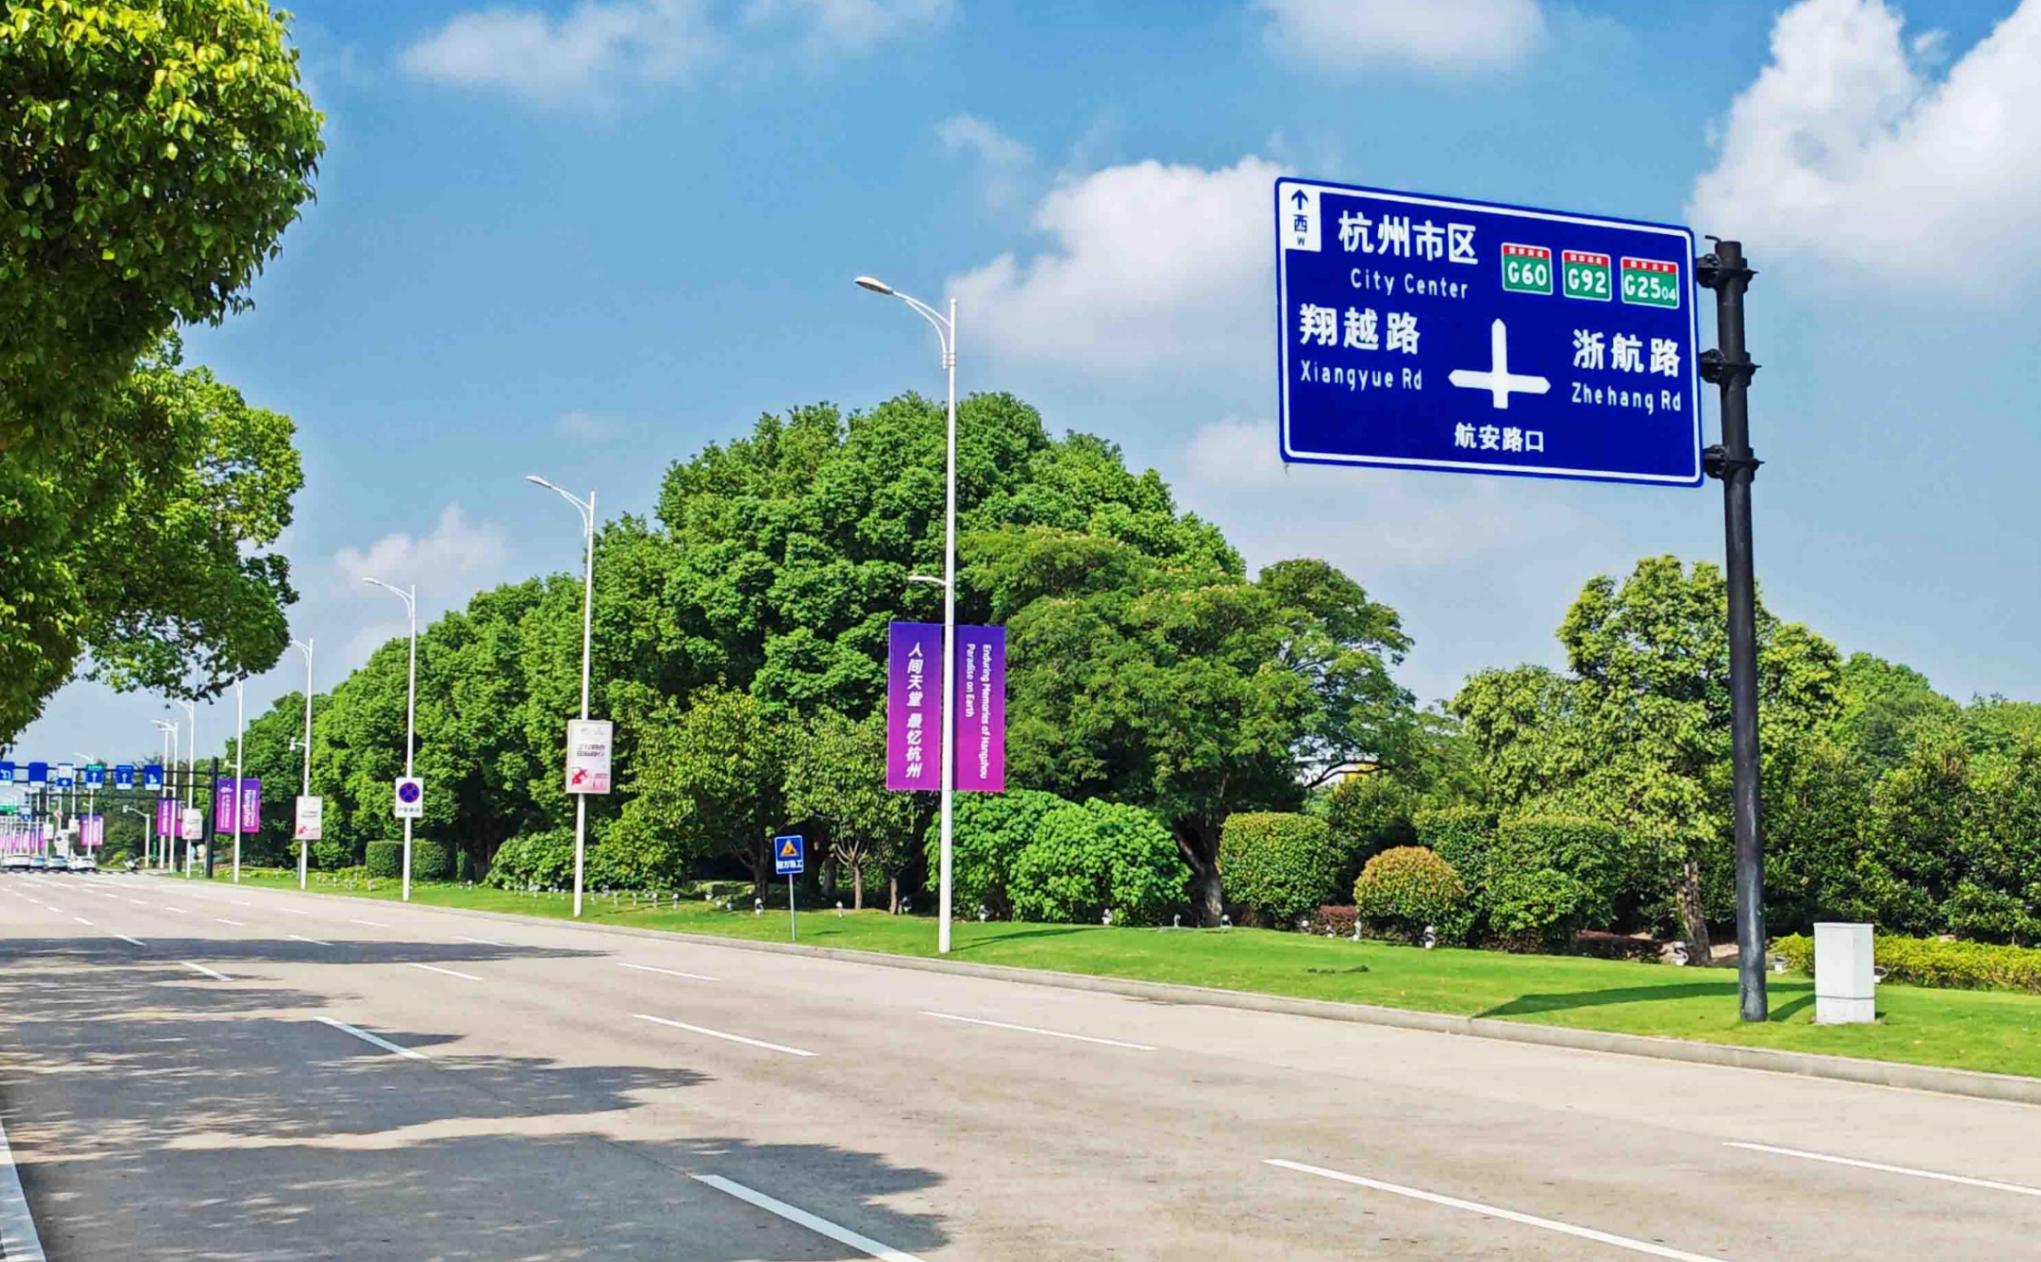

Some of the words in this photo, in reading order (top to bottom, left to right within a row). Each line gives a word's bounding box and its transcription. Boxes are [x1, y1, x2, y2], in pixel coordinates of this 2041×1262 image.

[1293, 214, 1308, 233] 西
[1338, 210, 1478, 264] 杭州市区
[1297, 236, 1304, 246] W
[1351, 268, 1394, 295] City
[1405, 274, 1467, 298] Center
[1508, 262, 1546, 285] G60
[1569, 269, 1606, 293] G92
[1300, 304, 1420, 354] 翔越路
[1573, 330, 1680, 377] 浙航路
[1302, 361, 1393, 390] Xiangyue
[1403, 368, 1421, 389] Rd
[1573, 383, 1653, 414] Zhehang
[1662, 390, 1680, 411] Rd
[1455, 422, 1543, 452] 航安路口
